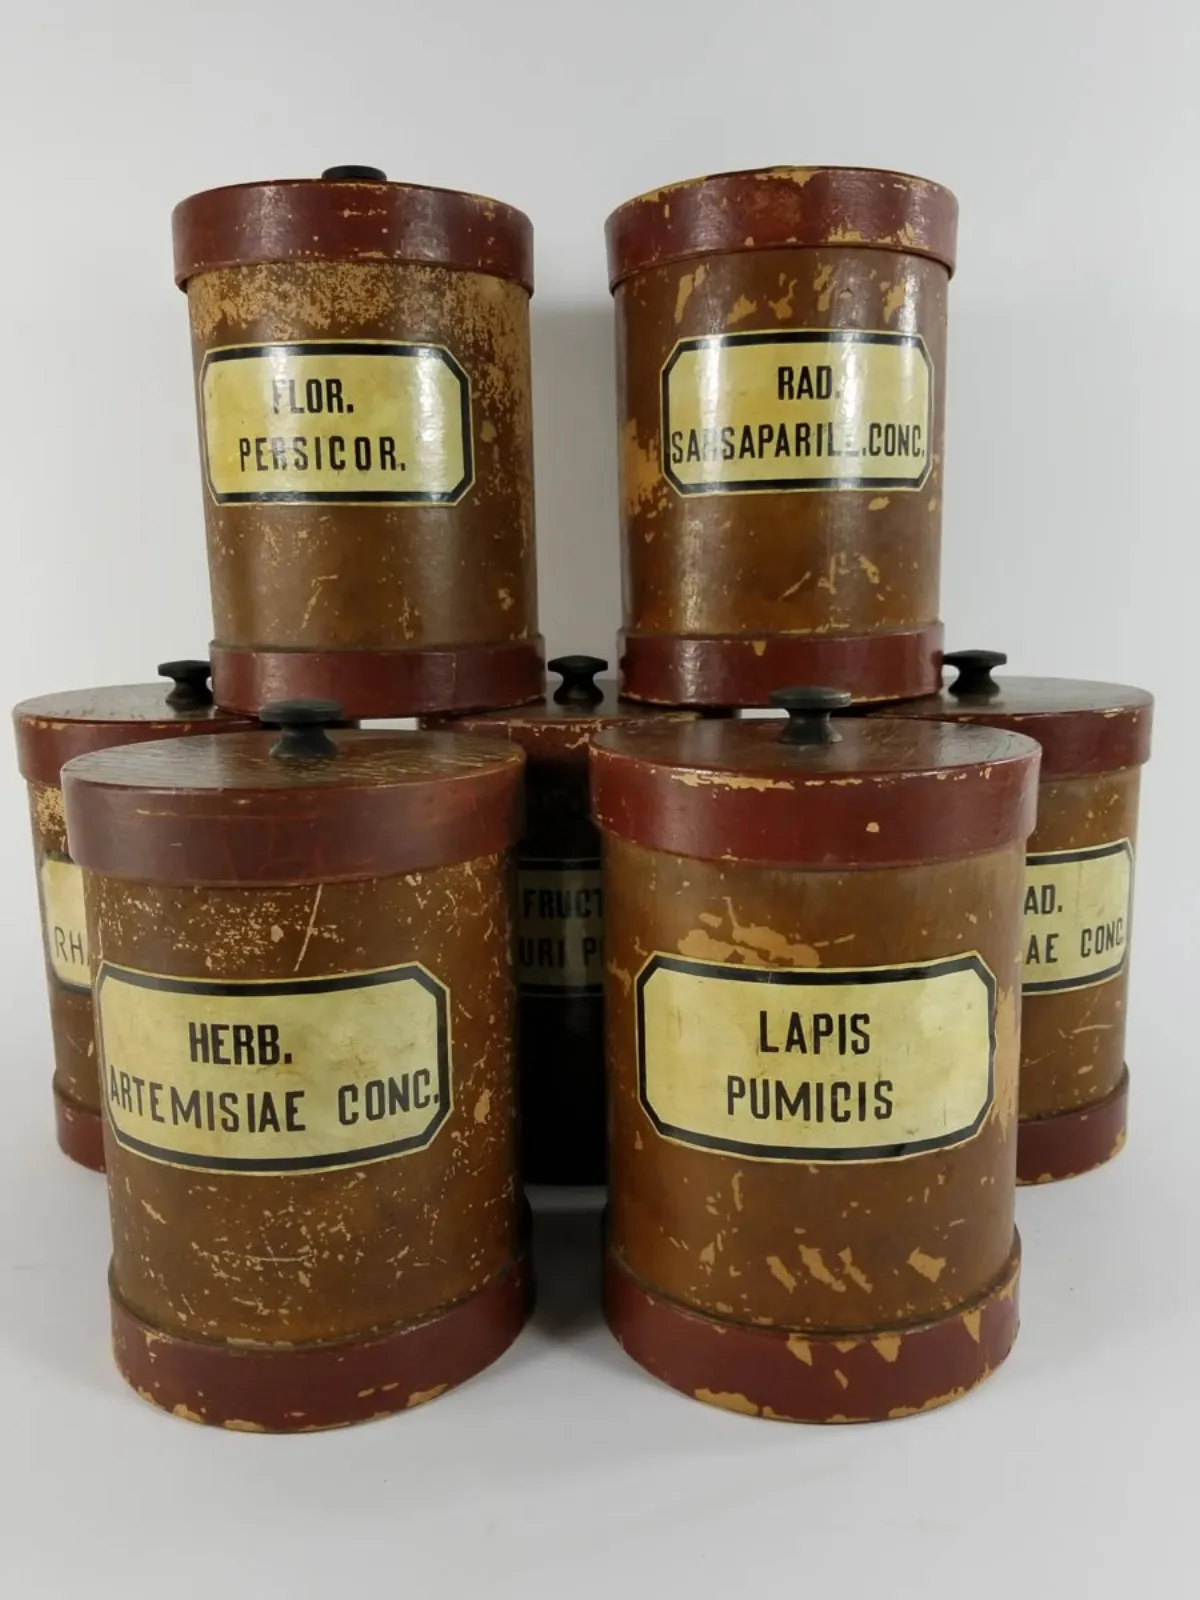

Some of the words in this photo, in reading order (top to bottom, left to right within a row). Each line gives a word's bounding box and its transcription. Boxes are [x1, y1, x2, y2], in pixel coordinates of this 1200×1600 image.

[272, 378, 354, 414] FLOR.
[777, 365, 841, 401] RAD.
[239, 435, 406, 472] PERSICOR.
[54, 926, 91, 967] RH
[188, 1022, 293, 1065] HERB.
[759, 1010, 870, 1055] LAPIS
[107, 1064, 306, 1133] ARTEMISIAE
[337, 1068, 441, 1126] CONC.
[727, 1074, 894, 1123] PUMICIS
